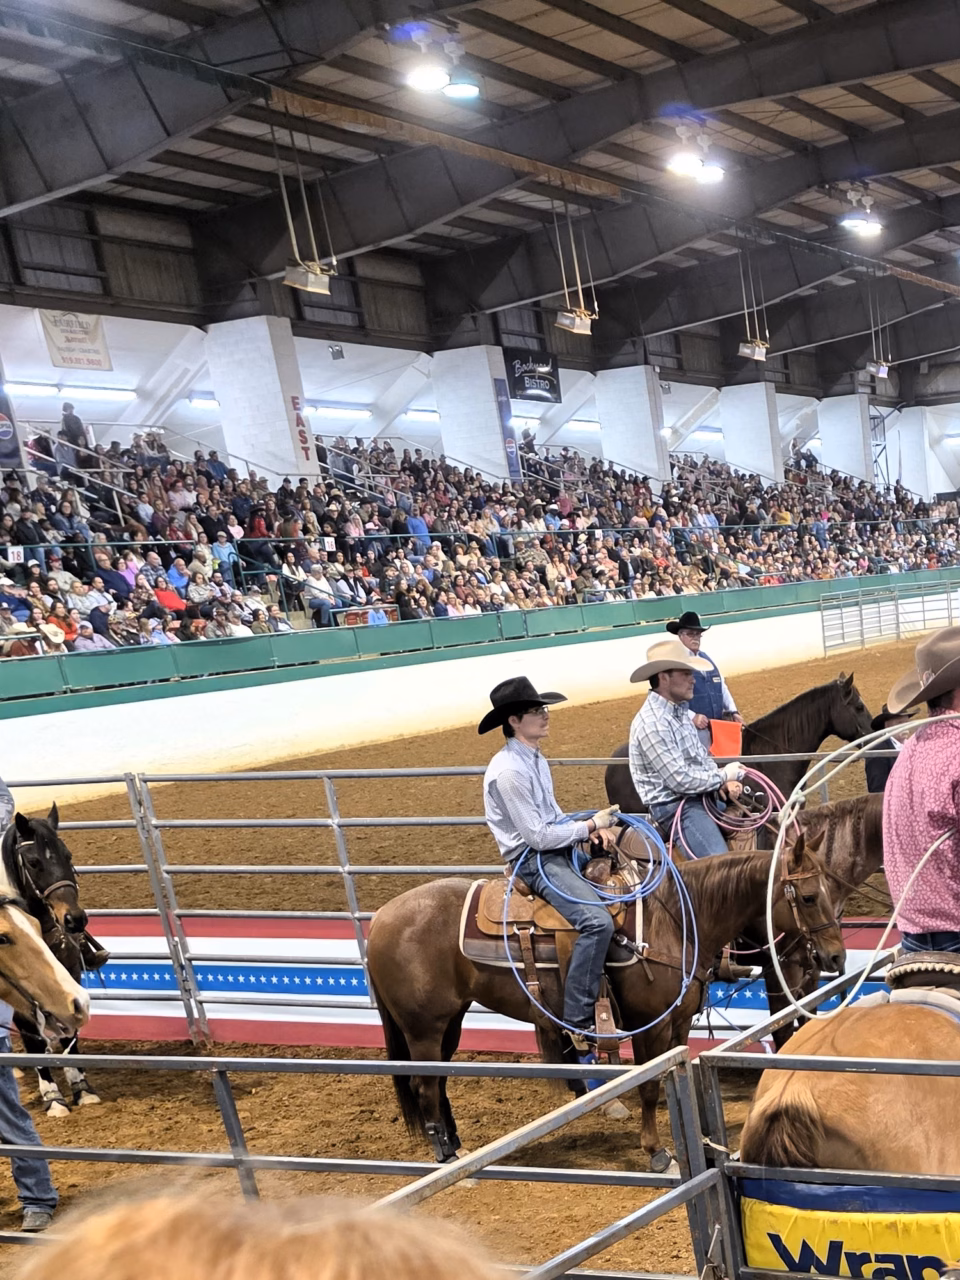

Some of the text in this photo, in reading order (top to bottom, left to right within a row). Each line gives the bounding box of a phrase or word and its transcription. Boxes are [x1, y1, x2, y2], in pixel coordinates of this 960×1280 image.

[524, 377, 550, 389] BISTRO
[291, 396, 310, 461] EAST
[11, 551, 22, 561] 18
